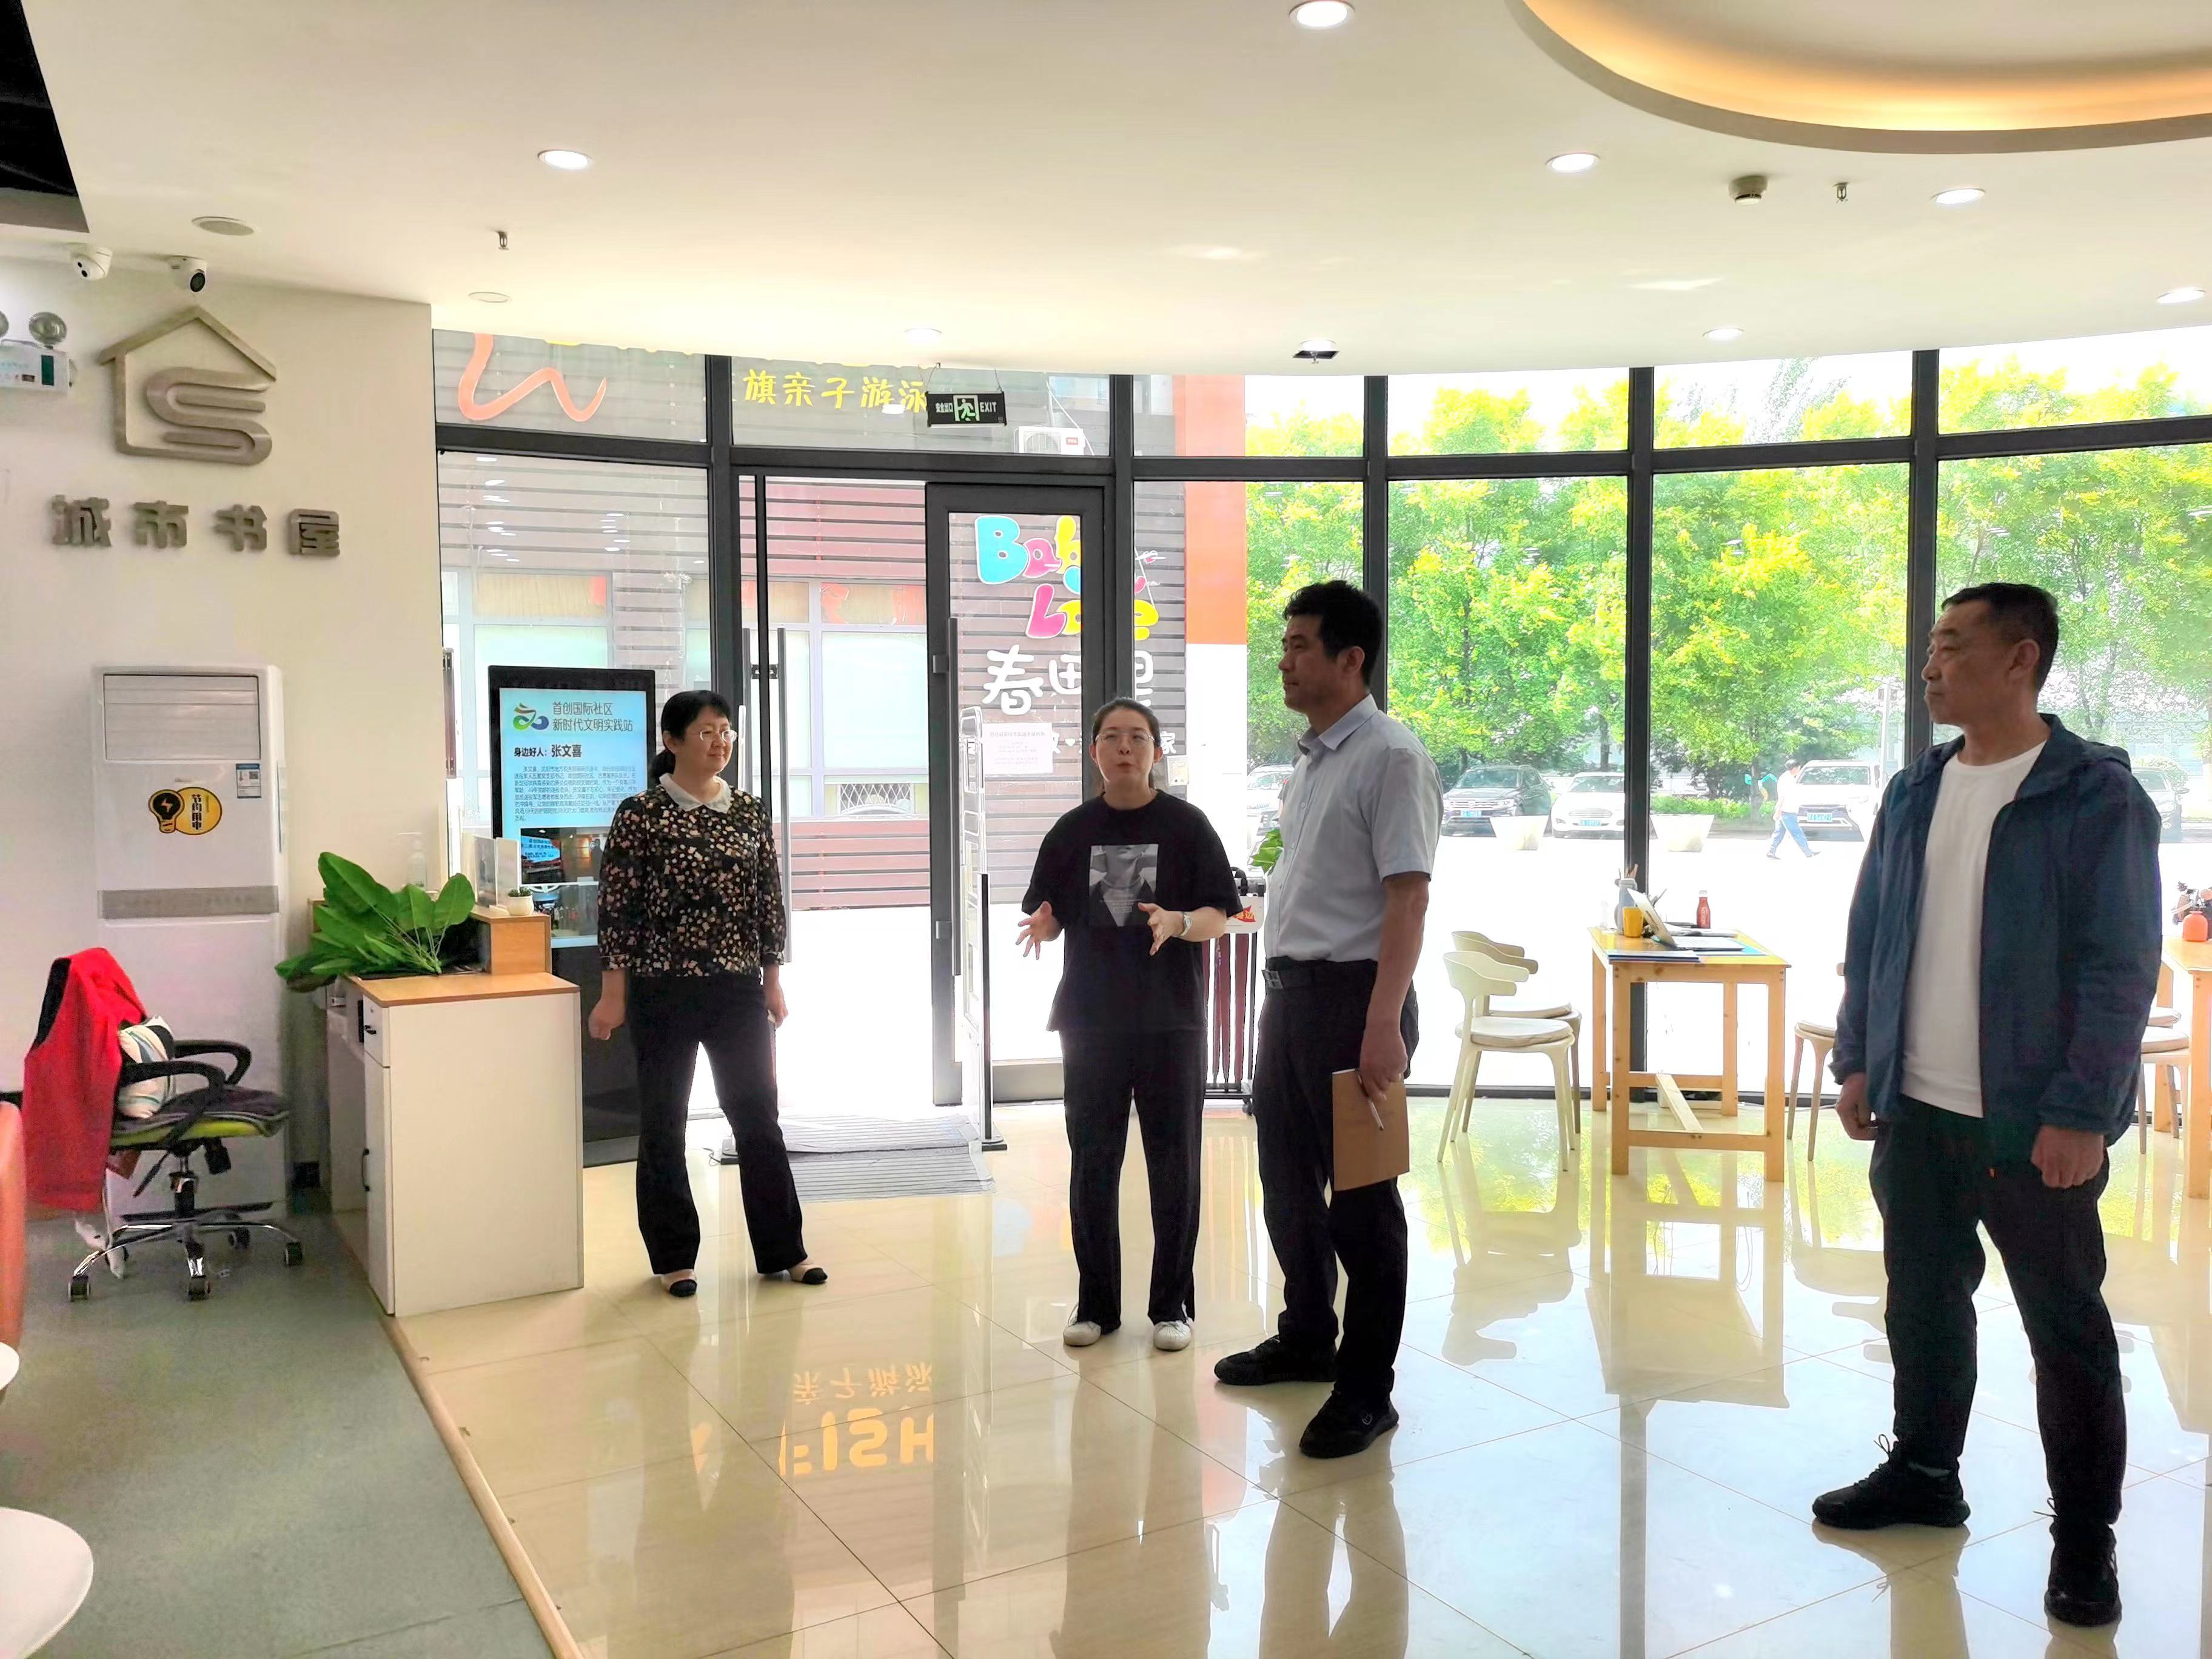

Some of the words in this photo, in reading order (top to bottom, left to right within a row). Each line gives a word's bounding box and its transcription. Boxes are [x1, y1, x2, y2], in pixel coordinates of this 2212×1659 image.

[743, 369, 927, 413] 旗亲子游泳
[979, 401, 997, 413] EXIT
[50, 494, 341, 558] 城市书屋
[552, 702, 614, 716] 首创国际社区
[552, 719, 634, 732] 新时代文明实践站
[551, 744, 582, 758] 张文喜
